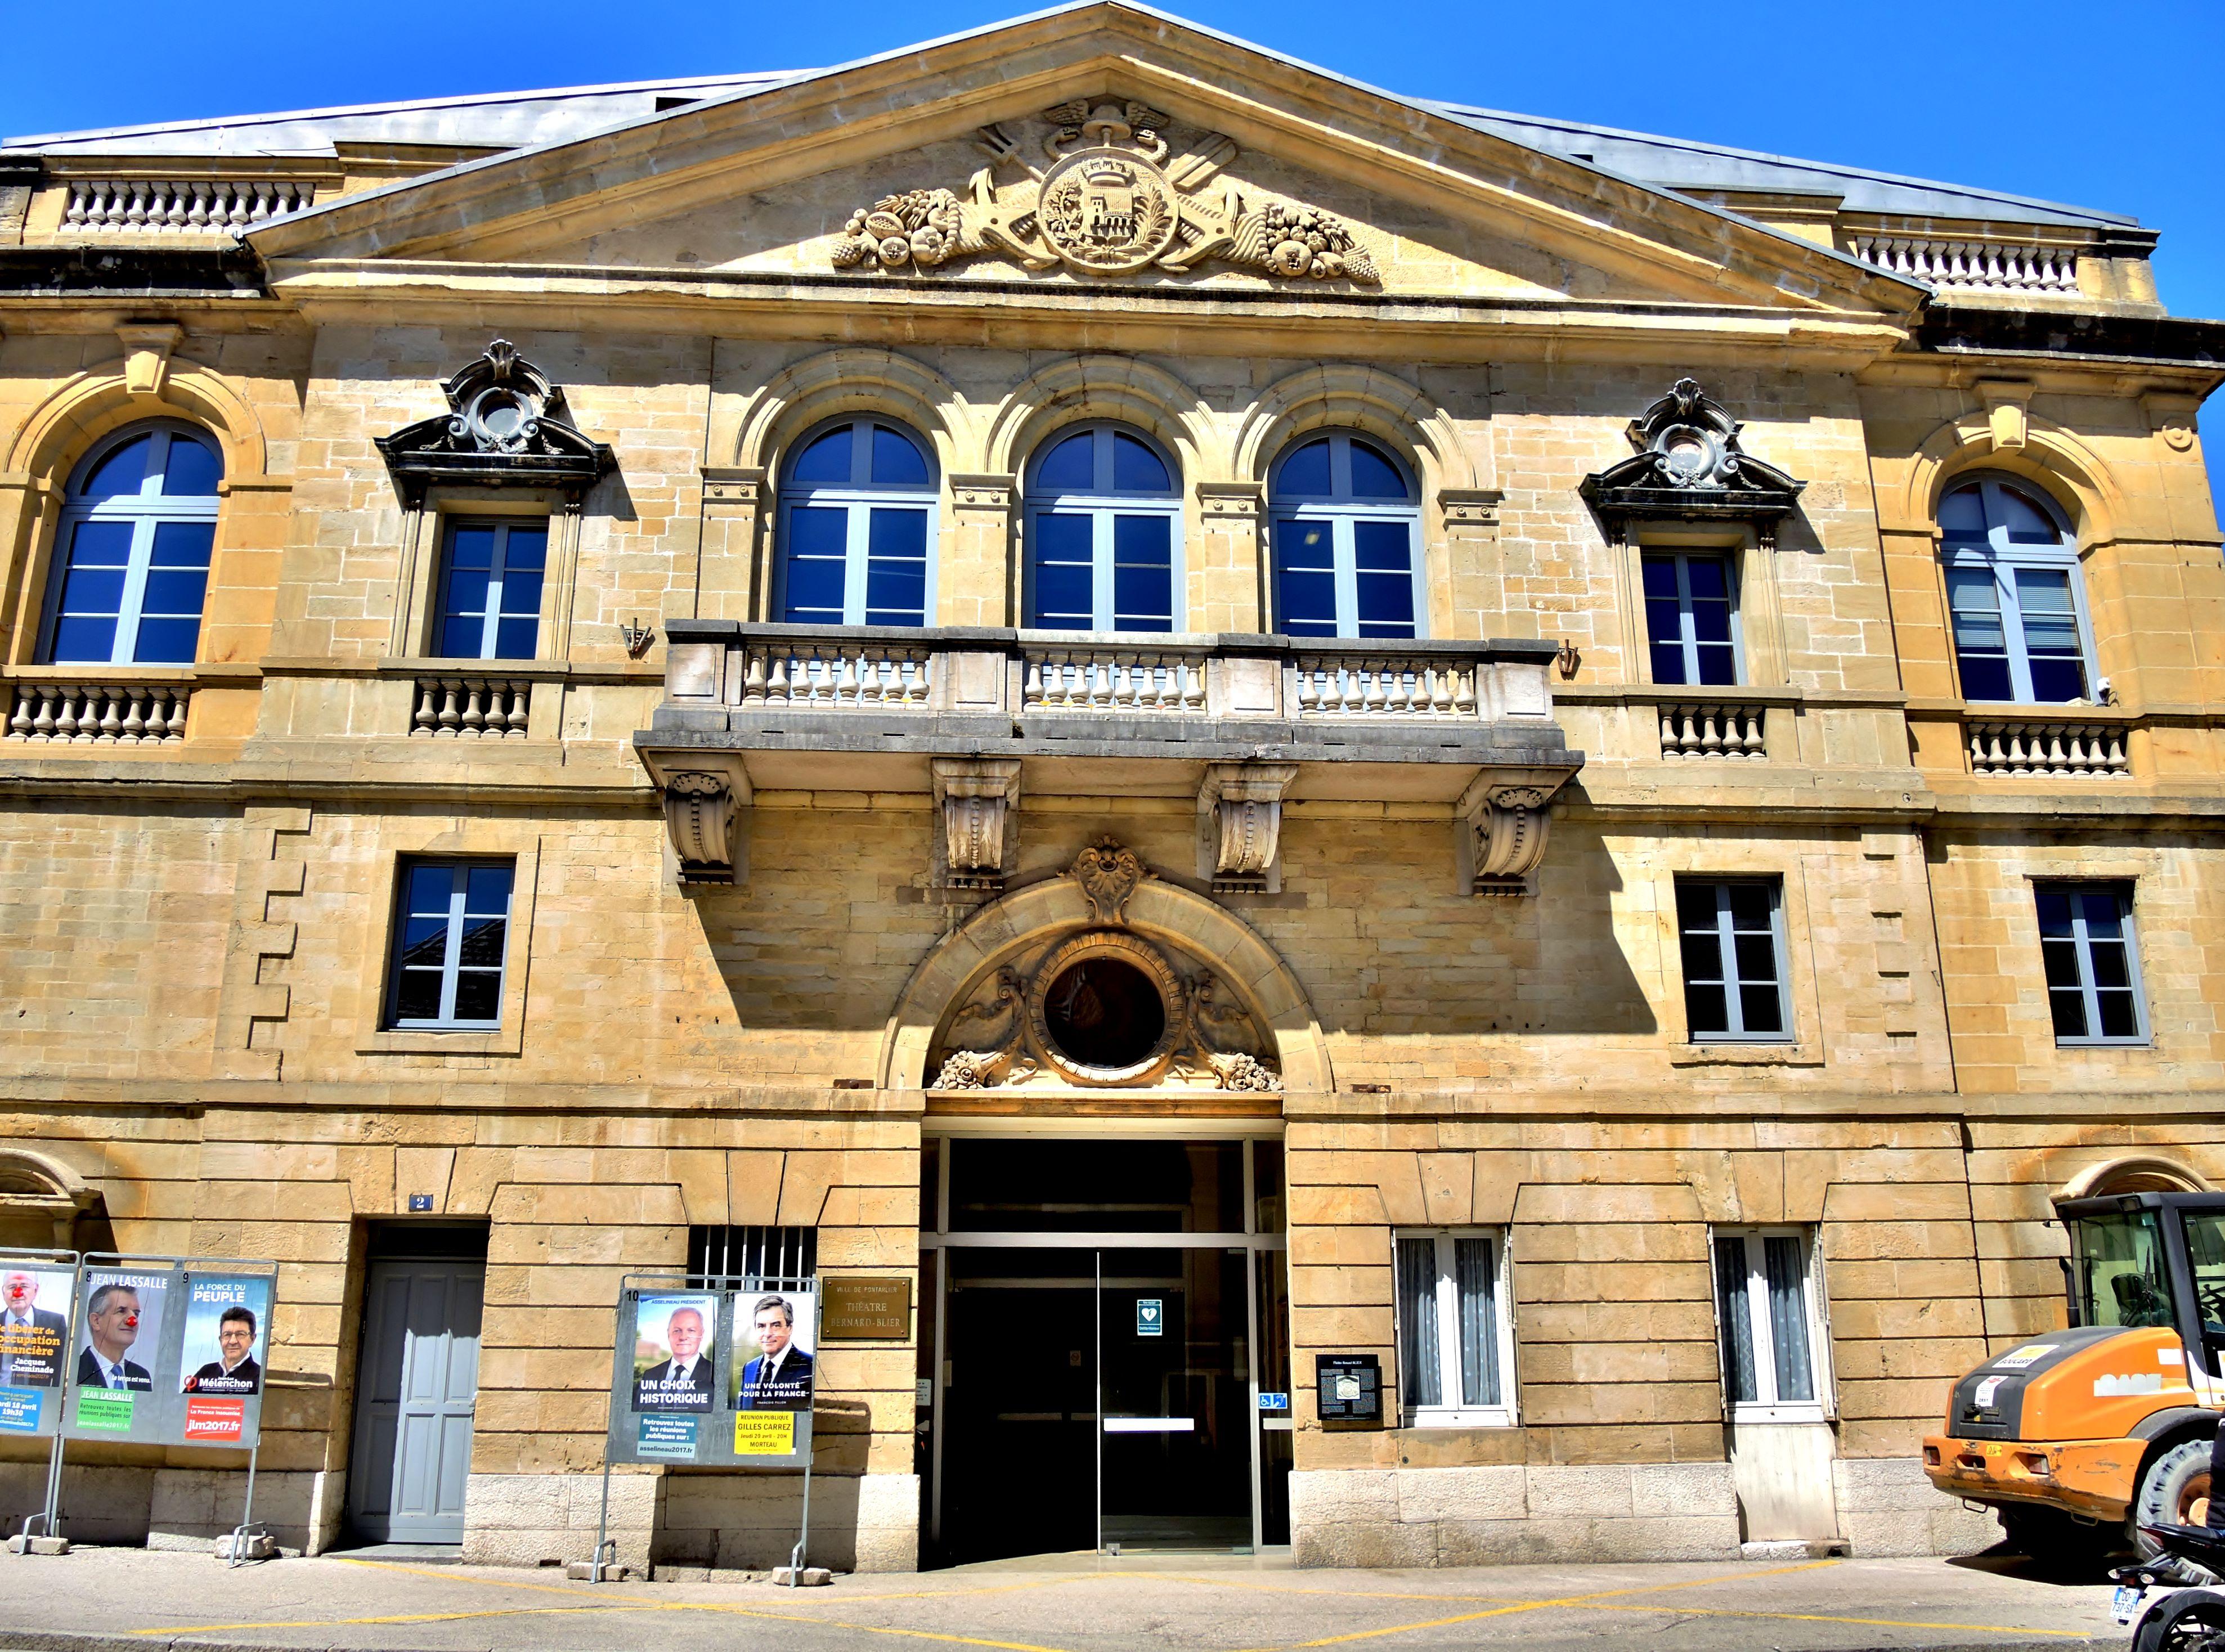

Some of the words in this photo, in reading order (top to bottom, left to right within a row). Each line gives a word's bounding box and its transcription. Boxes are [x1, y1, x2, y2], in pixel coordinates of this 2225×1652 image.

[416, 1197, 424, 1209] 2
[86, 1271, 92, 1282] 8
[91, 1273, 116, 1286] JEAN
[119, 1276, 168, 1289] LASSALLE
[183, 1272, 189, 1283] 9
[194, 1291, 245, 1303] PEUPLE
[627, 1290, 639, 1301] 10
[724, 1292, 735, 1303] 11
[846, 1301, 887, 1312] THÉATRE
[831, 1318, 900, 1327] BERNARD-BLIER
[8, 1323, 44, 1334] libérer
[15, 1358, 46, 1366] Jacques
[10, 1364, 54, 1373] Cheminade
[199, 1378, 253, 1388] Mélenchon
[641, 1380, 657, 1390] UN
[660, 1380, 696, 1390] CHOIX
[81, 1390, 99, 1399] JEAN
[100, 1392, 133, 1401] LASSALLE
[640, 1393, 708, 1404] HISTORIQUE
[187, 1420, 241, 1432] jlm2017.fr
